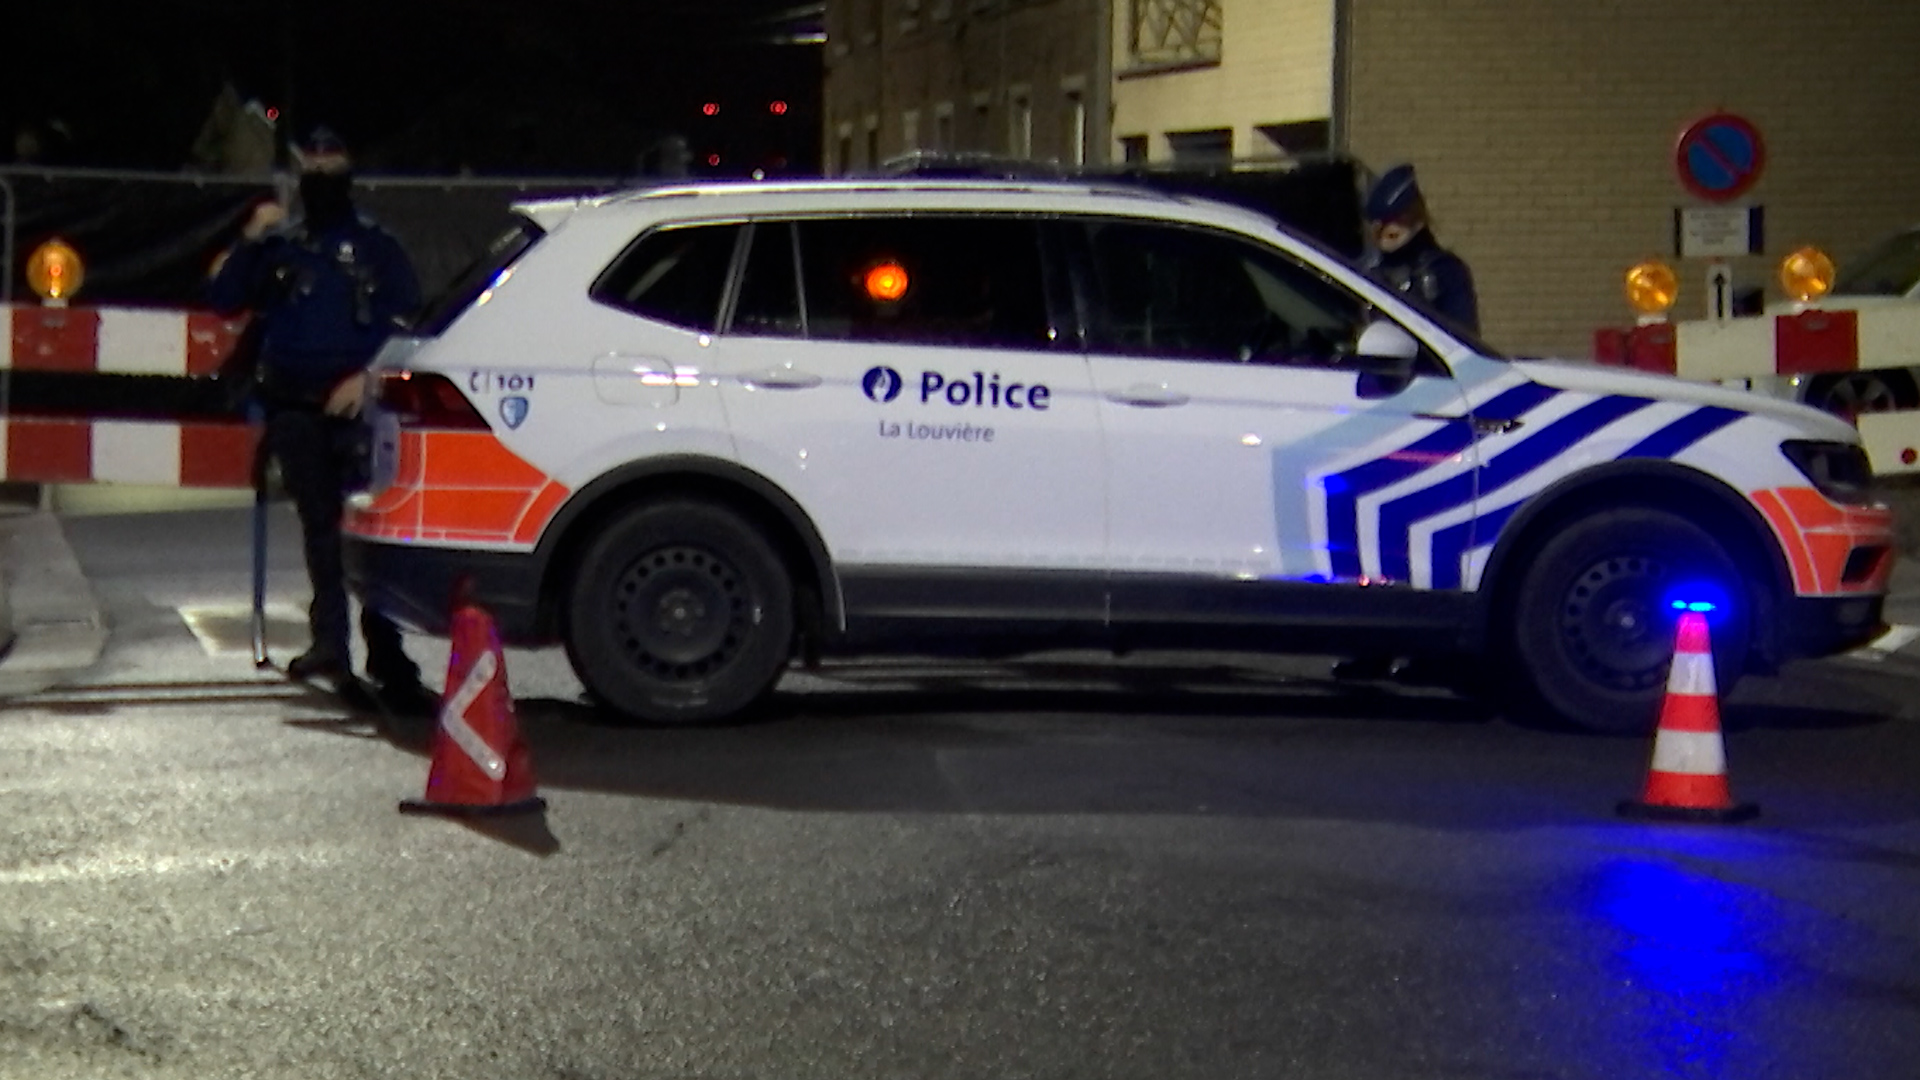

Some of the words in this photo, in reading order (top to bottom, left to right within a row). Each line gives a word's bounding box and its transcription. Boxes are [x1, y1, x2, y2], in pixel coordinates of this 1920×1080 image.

[497, 375, 534, 390] 101
[921, 372, 1051, 410] Police
[880, 420, 900, 437] La
[908, 421, 995, 442] Louvière
